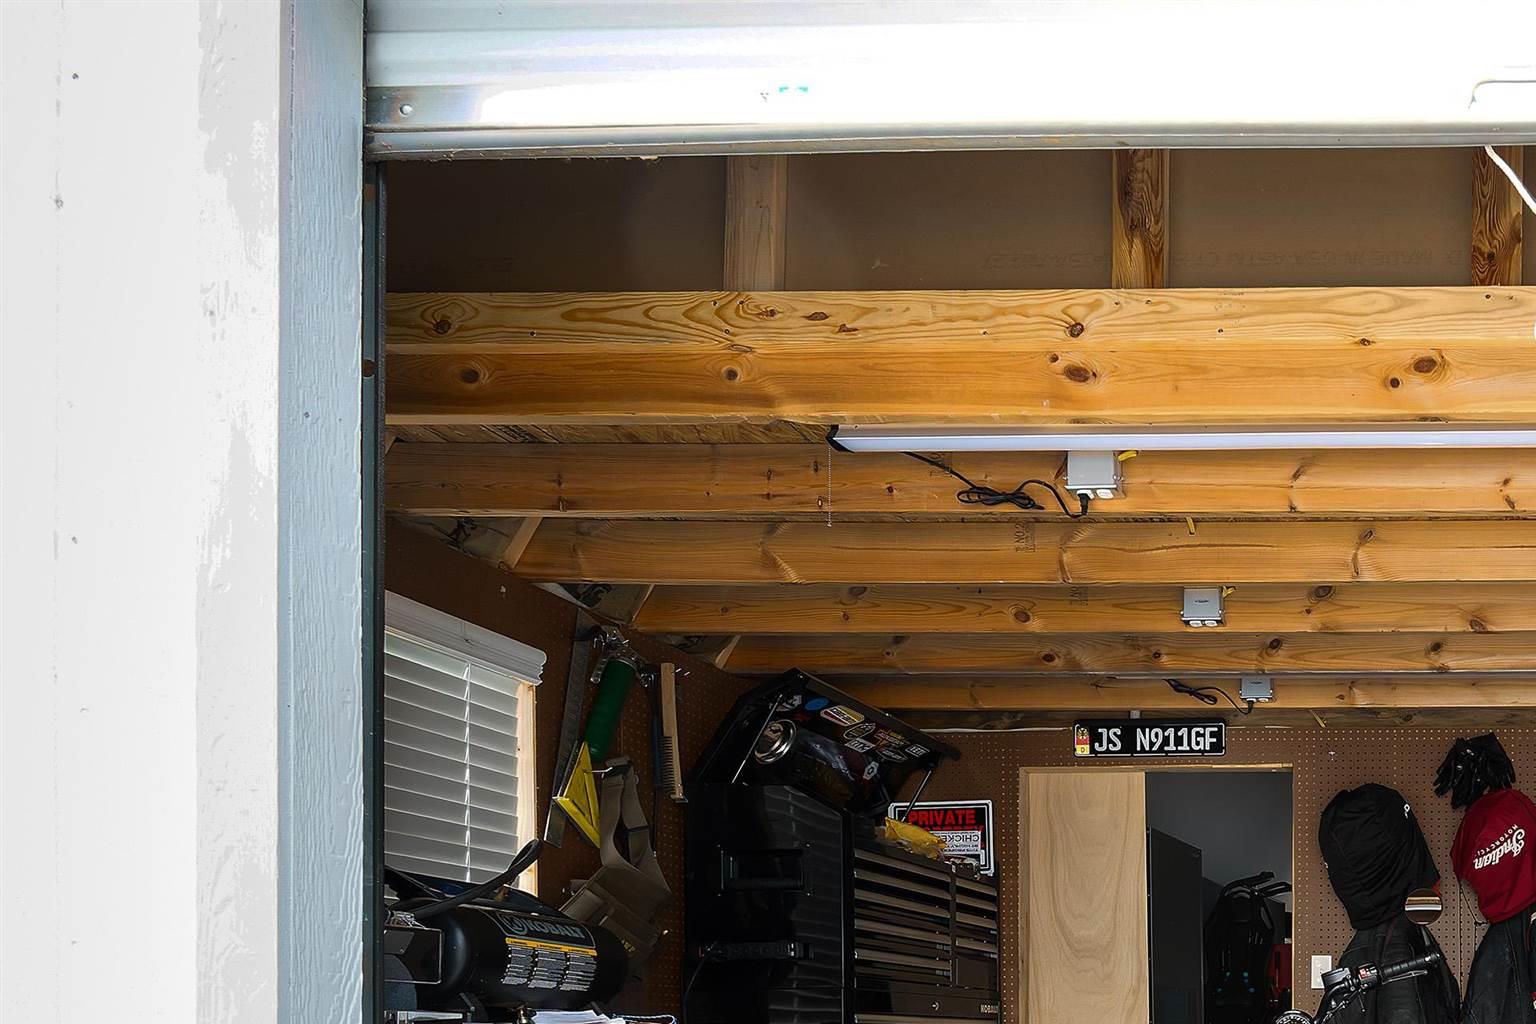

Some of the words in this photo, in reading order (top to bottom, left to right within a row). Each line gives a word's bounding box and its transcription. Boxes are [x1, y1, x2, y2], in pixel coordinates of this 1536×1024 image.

[1094, 727, 1122, 752] JS
[1136, 727, 1219, 751] N911GF
[908, 809, 976, 826] PRIVATE
[1473, 828, 1526, 870] Indian
